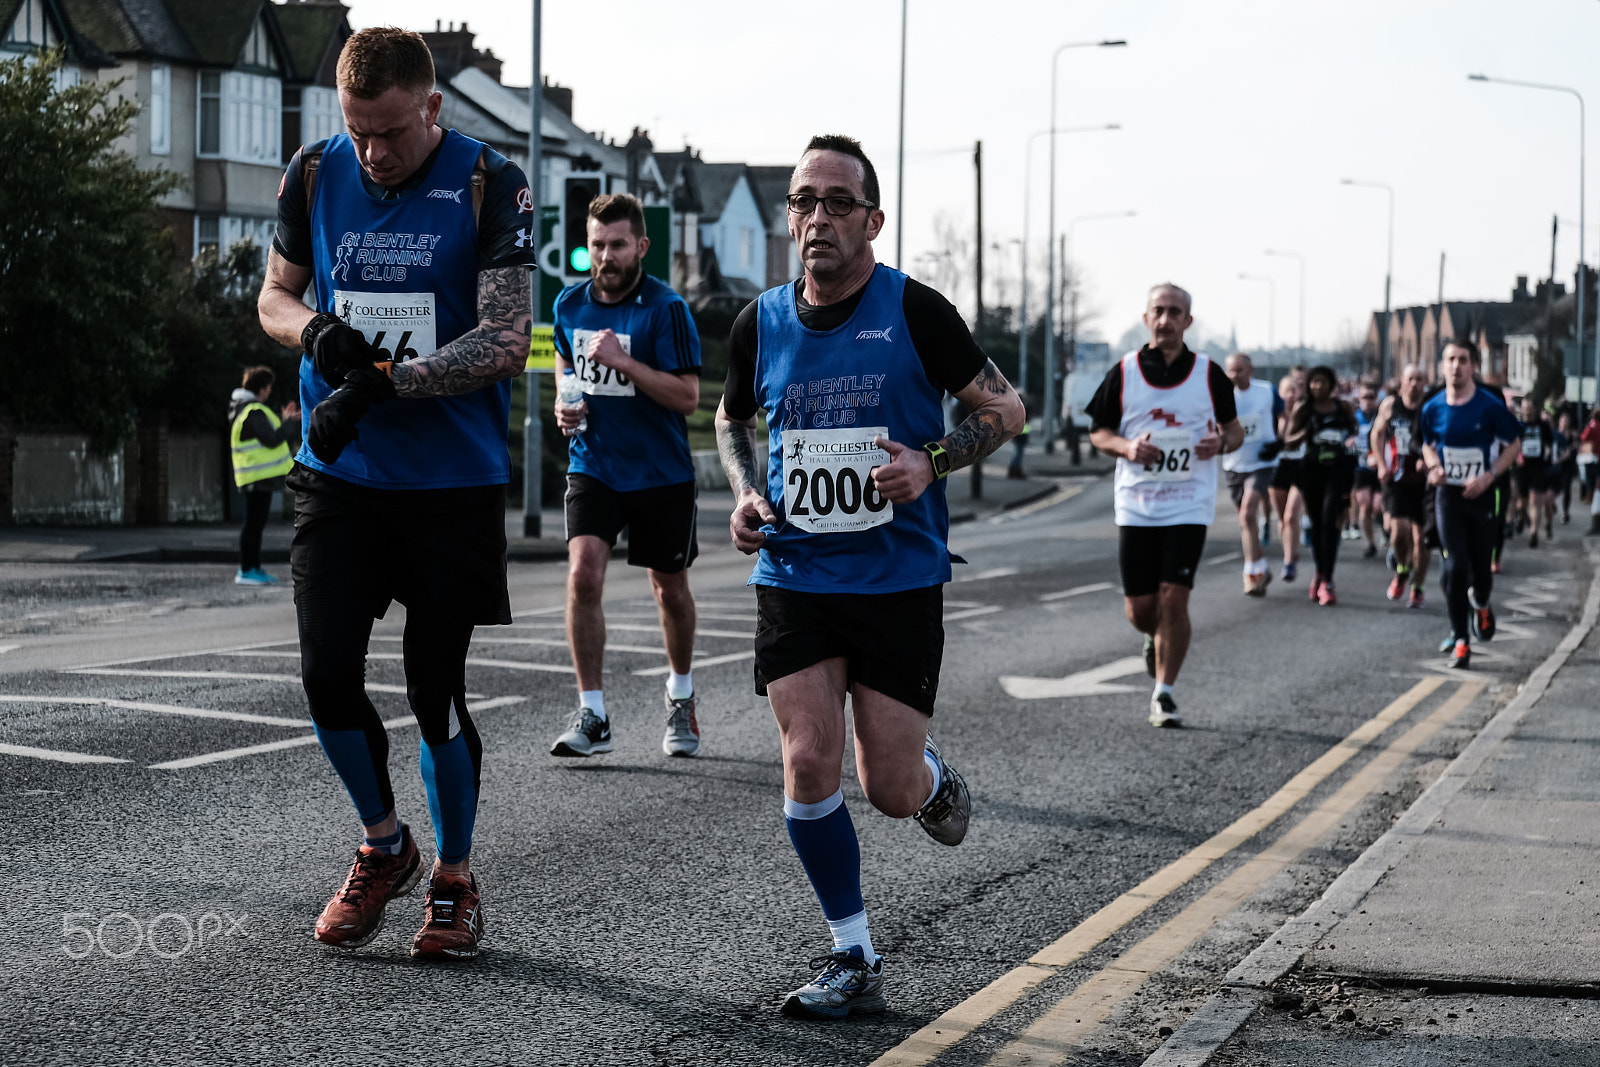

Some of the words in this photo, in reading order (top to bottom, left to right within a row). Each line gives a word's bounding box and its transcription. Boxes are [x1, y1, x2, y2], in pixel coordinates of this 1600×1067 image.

[342, 232, 361, 247] Gt
[362, 232, 441, 249] BENTLEY
[356, 249, 433, 267] RUNNING
[361, 266, 407, 281] CLUB
[355, 306, 431, 316] COLCHESTER
[787, 384, 805, 397] Gt
[808, 374, 886, 395] BENTLEY
[805, 391, 880, 412] RUNNING
[813, 410, 856, 427] CLUB
[834, 454, 884, 463] MARATHON
[788, 465, 889, 516] 2006
